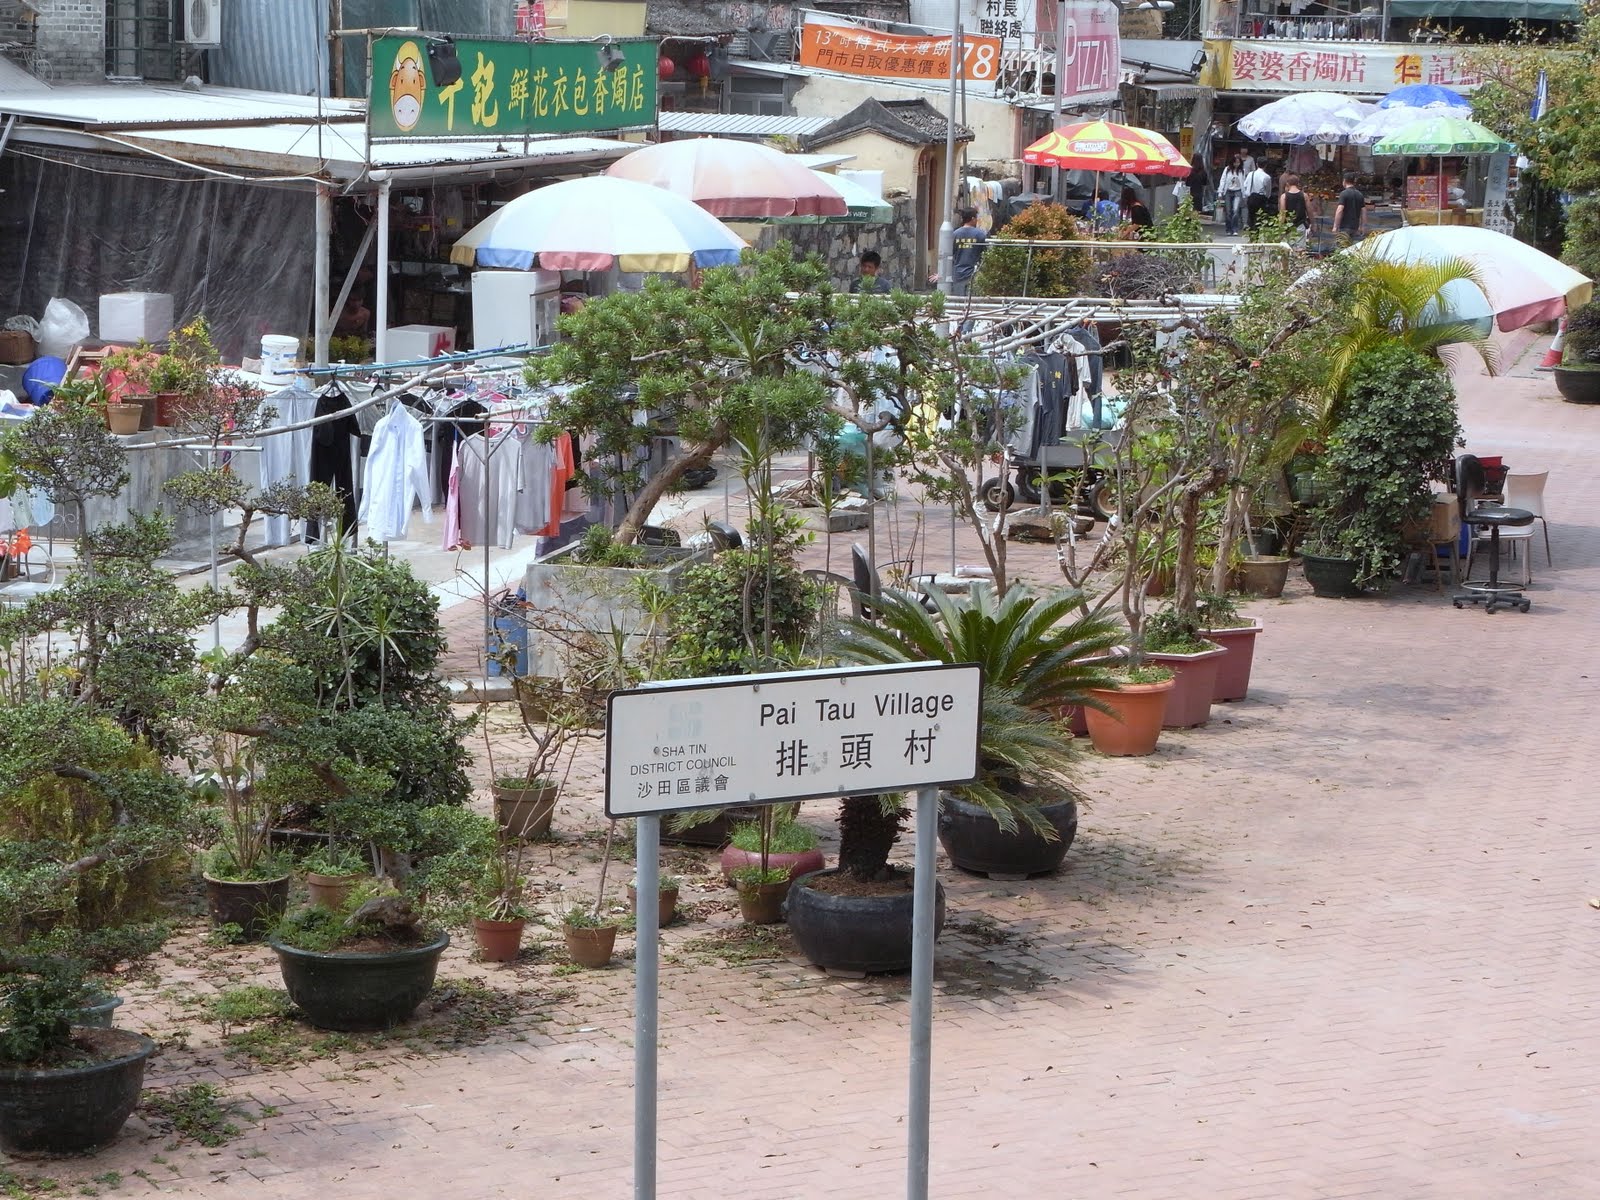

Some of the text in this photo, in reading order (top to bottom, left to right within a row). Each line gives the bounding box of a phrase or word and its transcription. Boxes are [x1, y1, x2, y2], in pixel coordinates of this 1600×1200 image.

[986, 0, 1018, 17] 村長
[980, 19, 1022, 39] 聯絡處
[1064, 17, 1109, 95] PIZZA
[1232, 50, 1367, 83] 婆婆香燭店
[508, 63, 645, 119] 鮮花衣包香燭店
[760, 692, 954, 727] Pai Tau Village
[661, 744, 707, 757] SHA TIN
[776, 728, 937, 777] 排頭村
[630, 756, 736, 775] DISTRICT COUNCIL
[638, 774, 729, 799] 沙田區議會
